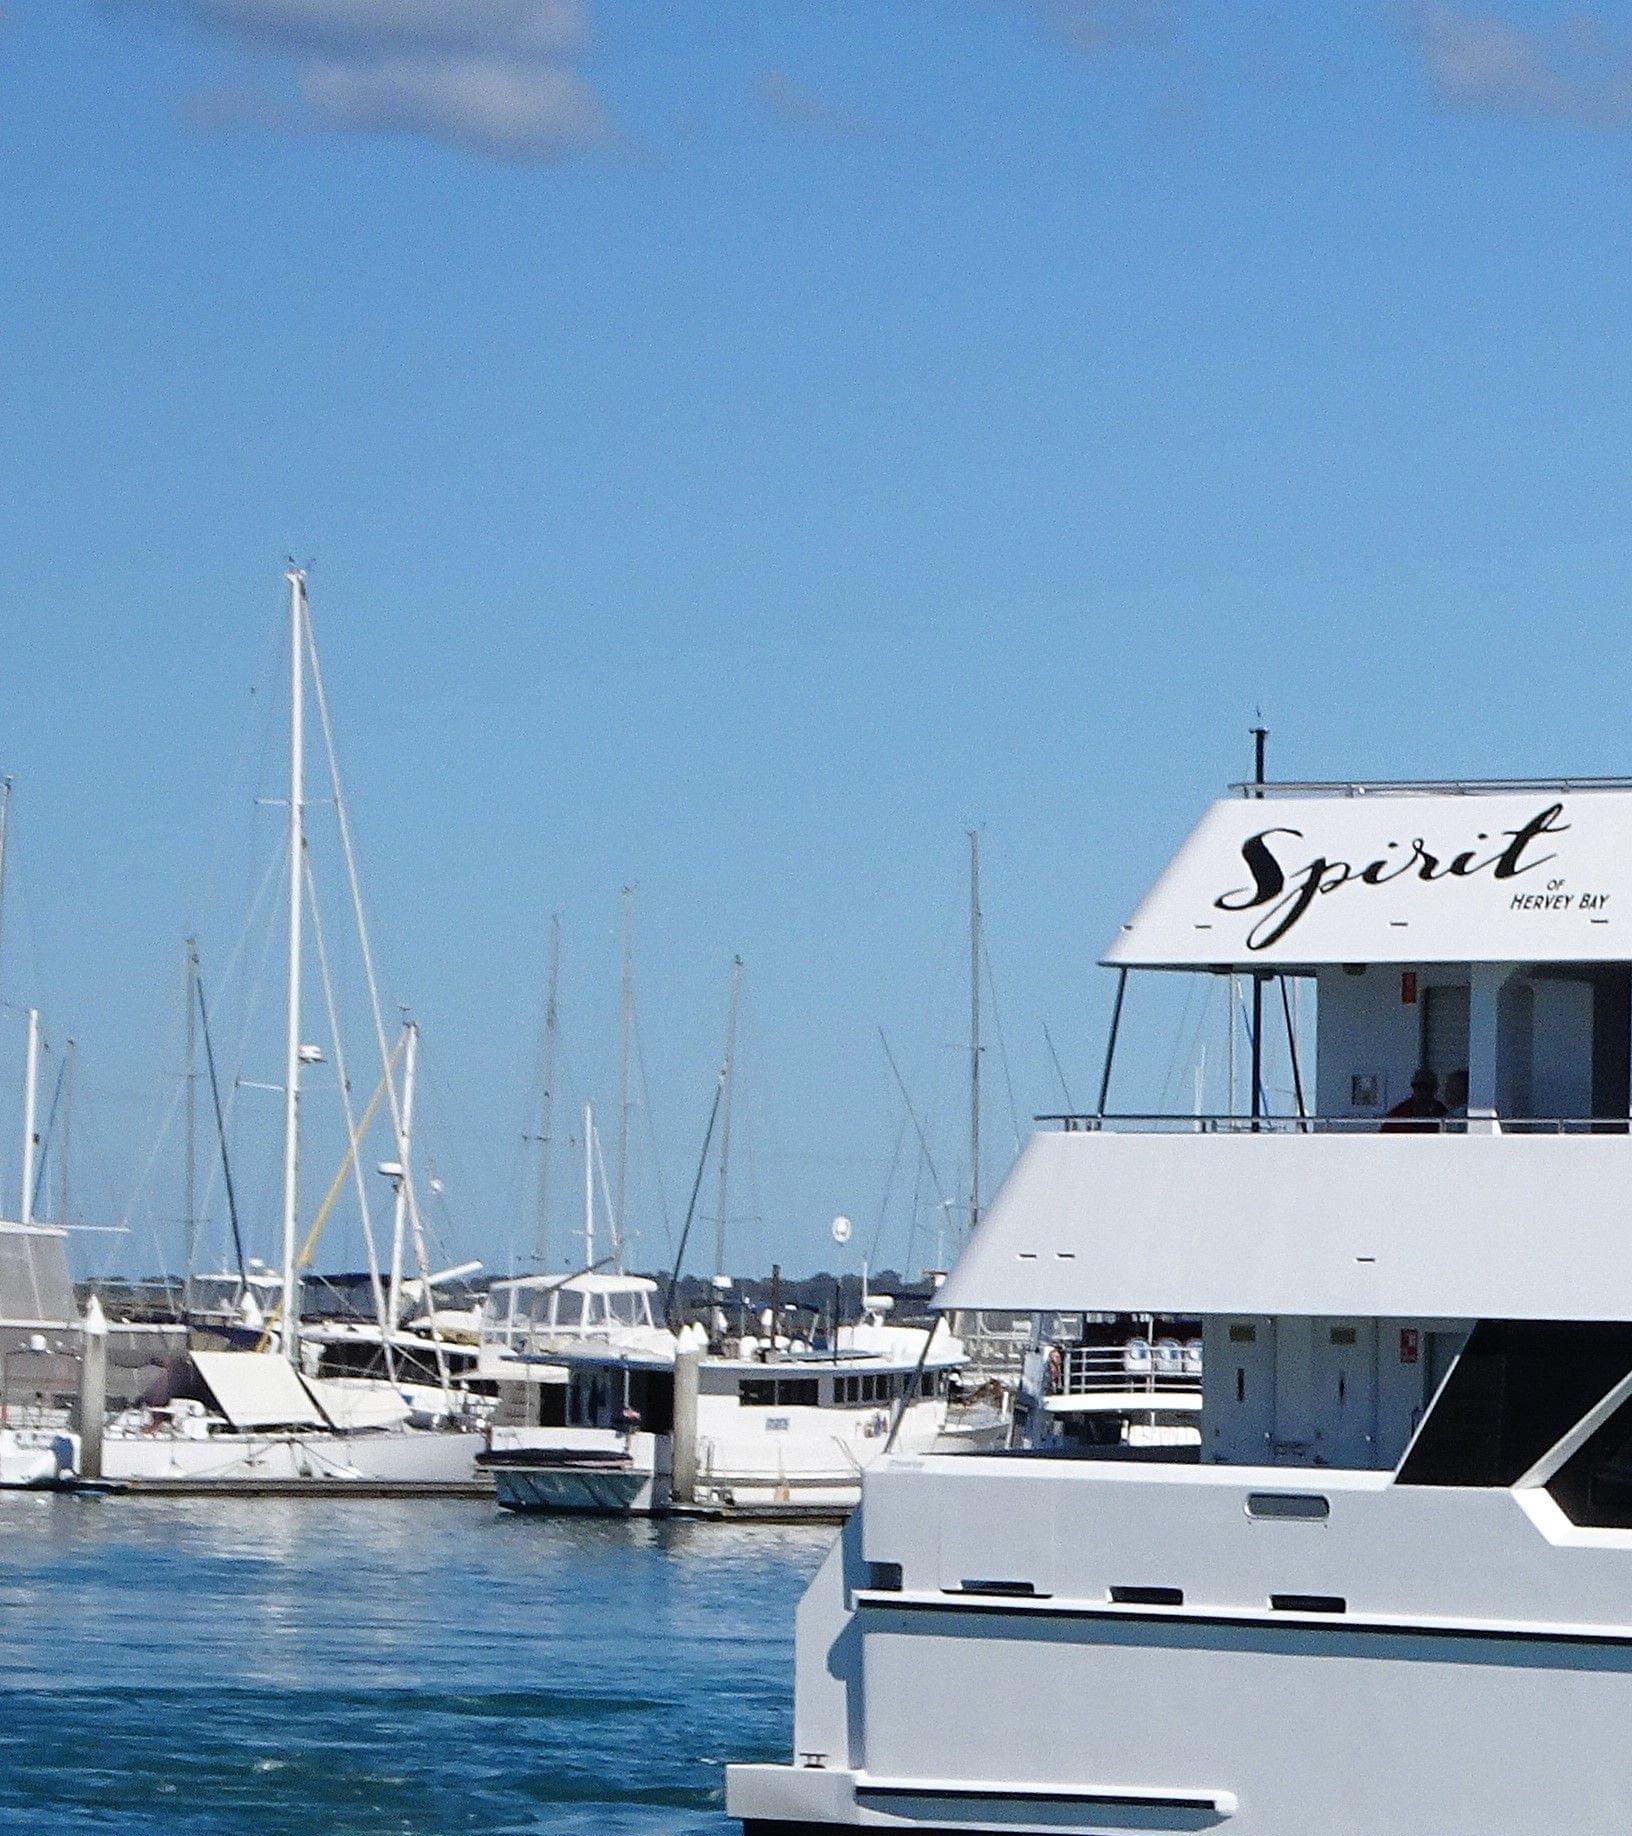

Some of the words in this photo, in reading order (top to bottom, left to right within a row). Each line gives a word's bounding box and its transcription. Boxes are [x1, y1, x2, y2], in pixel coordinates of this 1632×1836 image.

[1214, 802, 1571, 950] Spirit
[1546, 879, 1566, 891] OF
[1510, 893, 1575, 910] HERVEY
[1579, 892, 1610, 910] BAY
